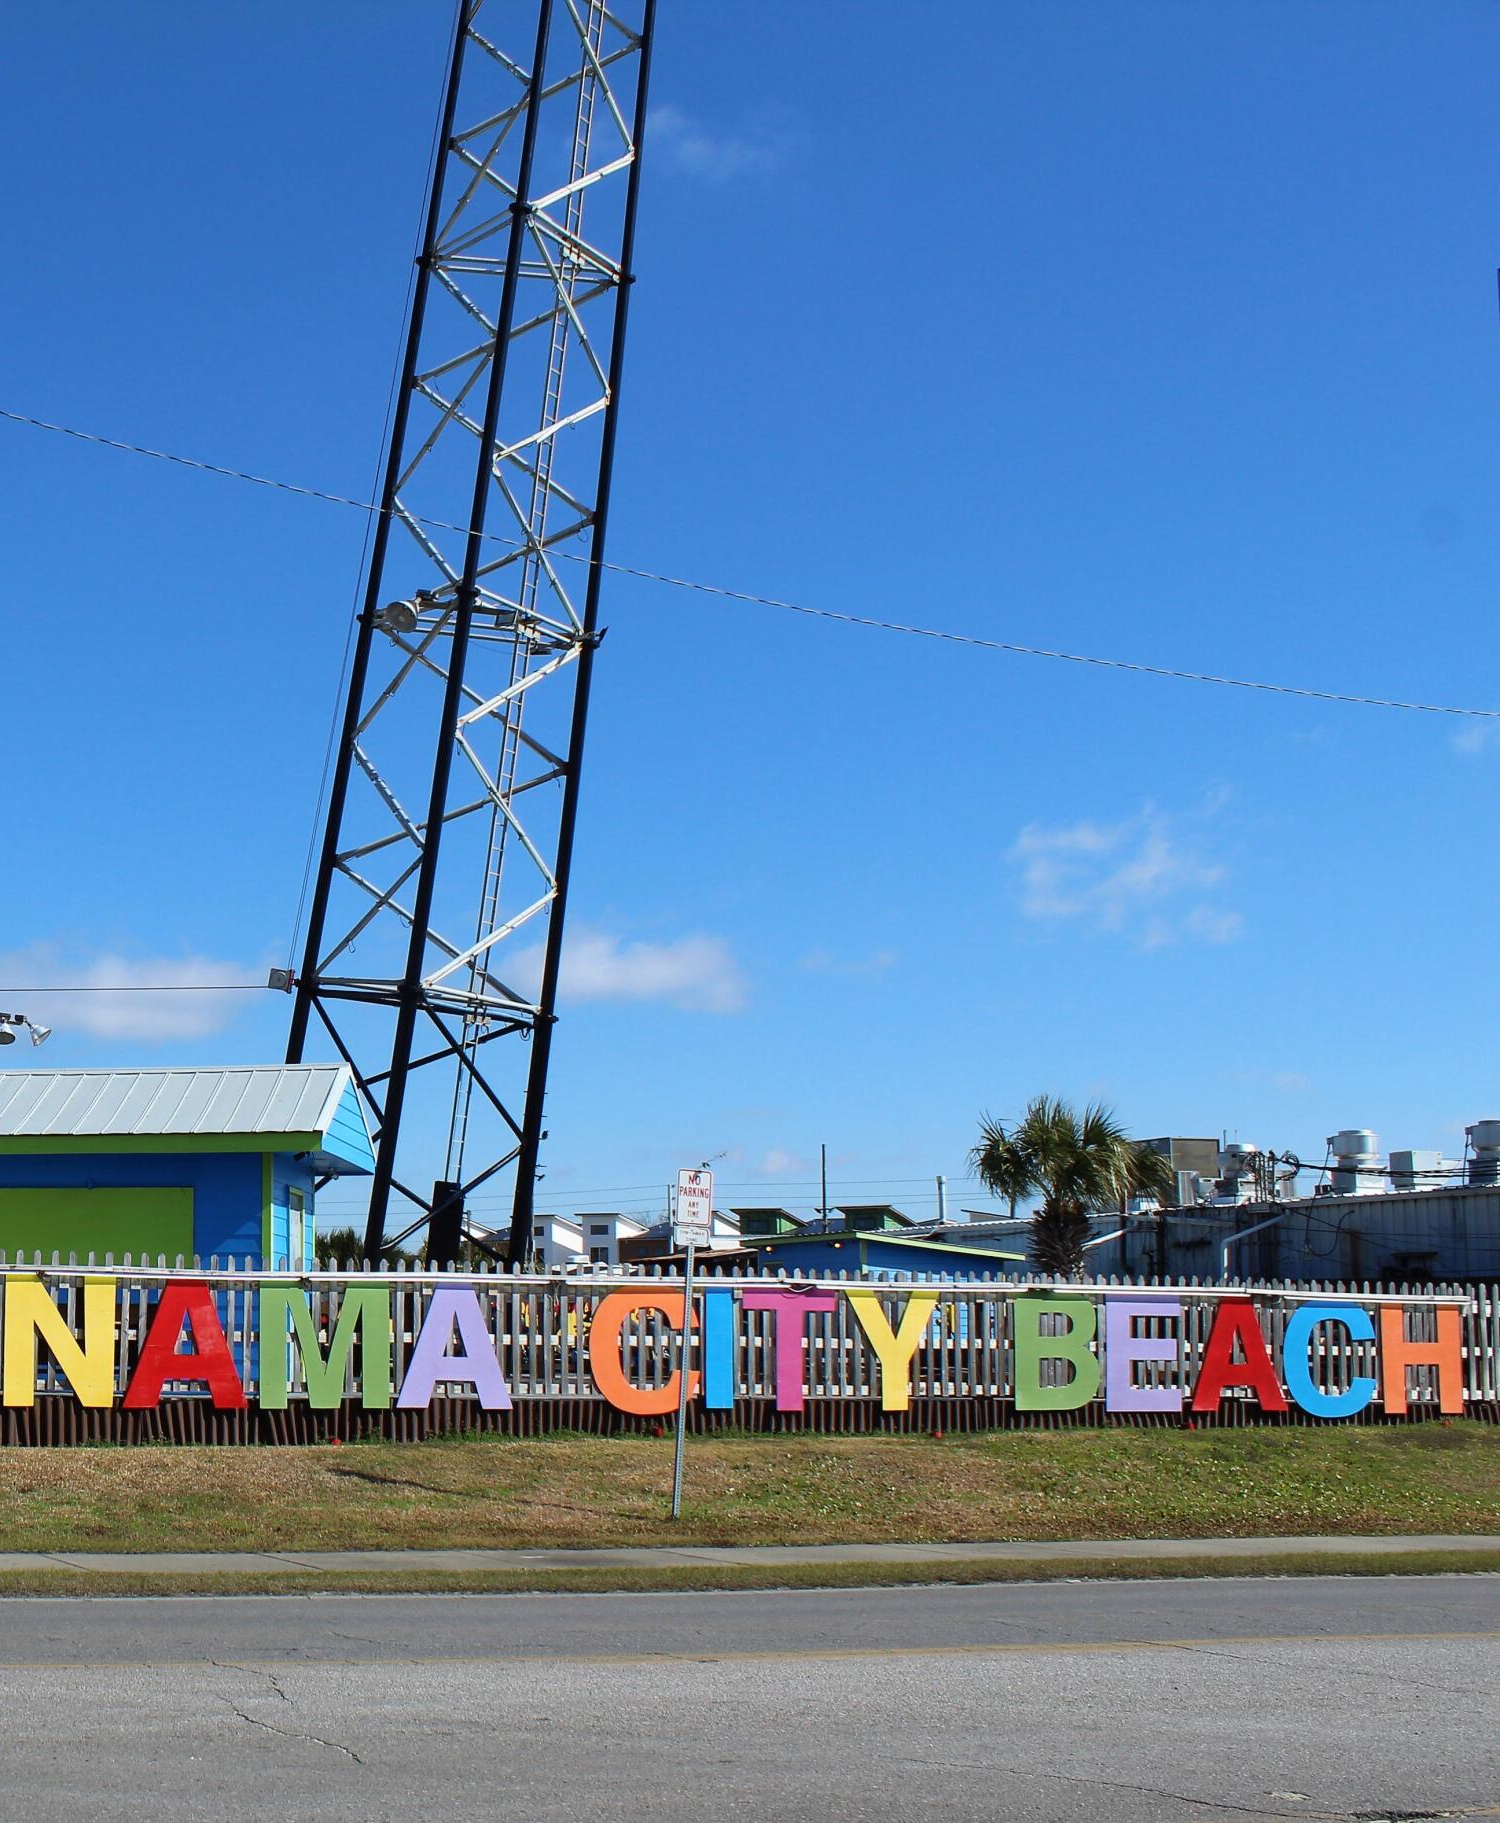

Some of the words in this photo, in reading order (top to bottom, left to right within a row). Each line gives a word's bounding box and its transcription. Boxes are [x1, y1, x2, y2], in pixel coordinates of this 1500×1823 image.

[688, 1175, 701, 1185] NO
[679, 1186, 709, 1198] PARKING
[688, 1200, 699, 1209] ANY
[687, 1210, 700, 1218] TIME
[588, 1285, 940, 1416] CITY
[1014, 1290, 1464, 1418] BEACH
